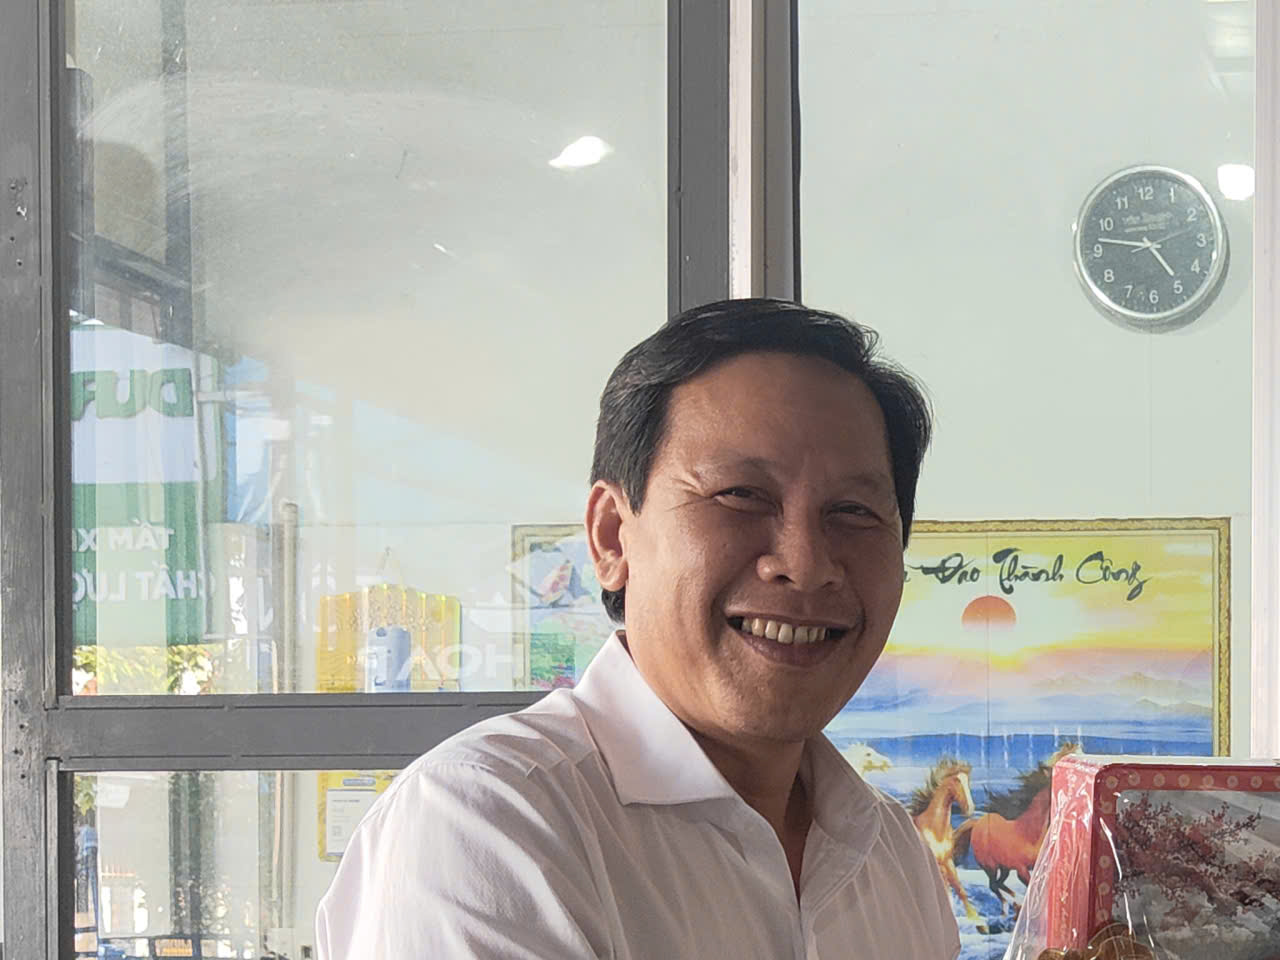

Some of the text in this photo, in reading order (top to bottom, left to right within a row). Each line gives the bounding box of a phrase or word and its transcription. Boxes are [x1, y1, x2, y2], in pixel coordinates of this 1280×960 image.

[1137, 186, 1154, 201] 12
[1169, 187, 1175, 203] 1
[1115, 196, 1129, 210] 11
[1187, 207, 1197, 222] 2
[1099, 217, 1114, 232] 10
[1196, 233, 1207, 248] 3
[1093, 244, 1103, 258] 9
[1190, 259, 1200, 274] 4
[1103, 269, 1115, 283] 8
[1124, 285, 1133, 298] 7
[1173, 280, 1184, 294] 5
[1149, 290, 1159, 304] 6
